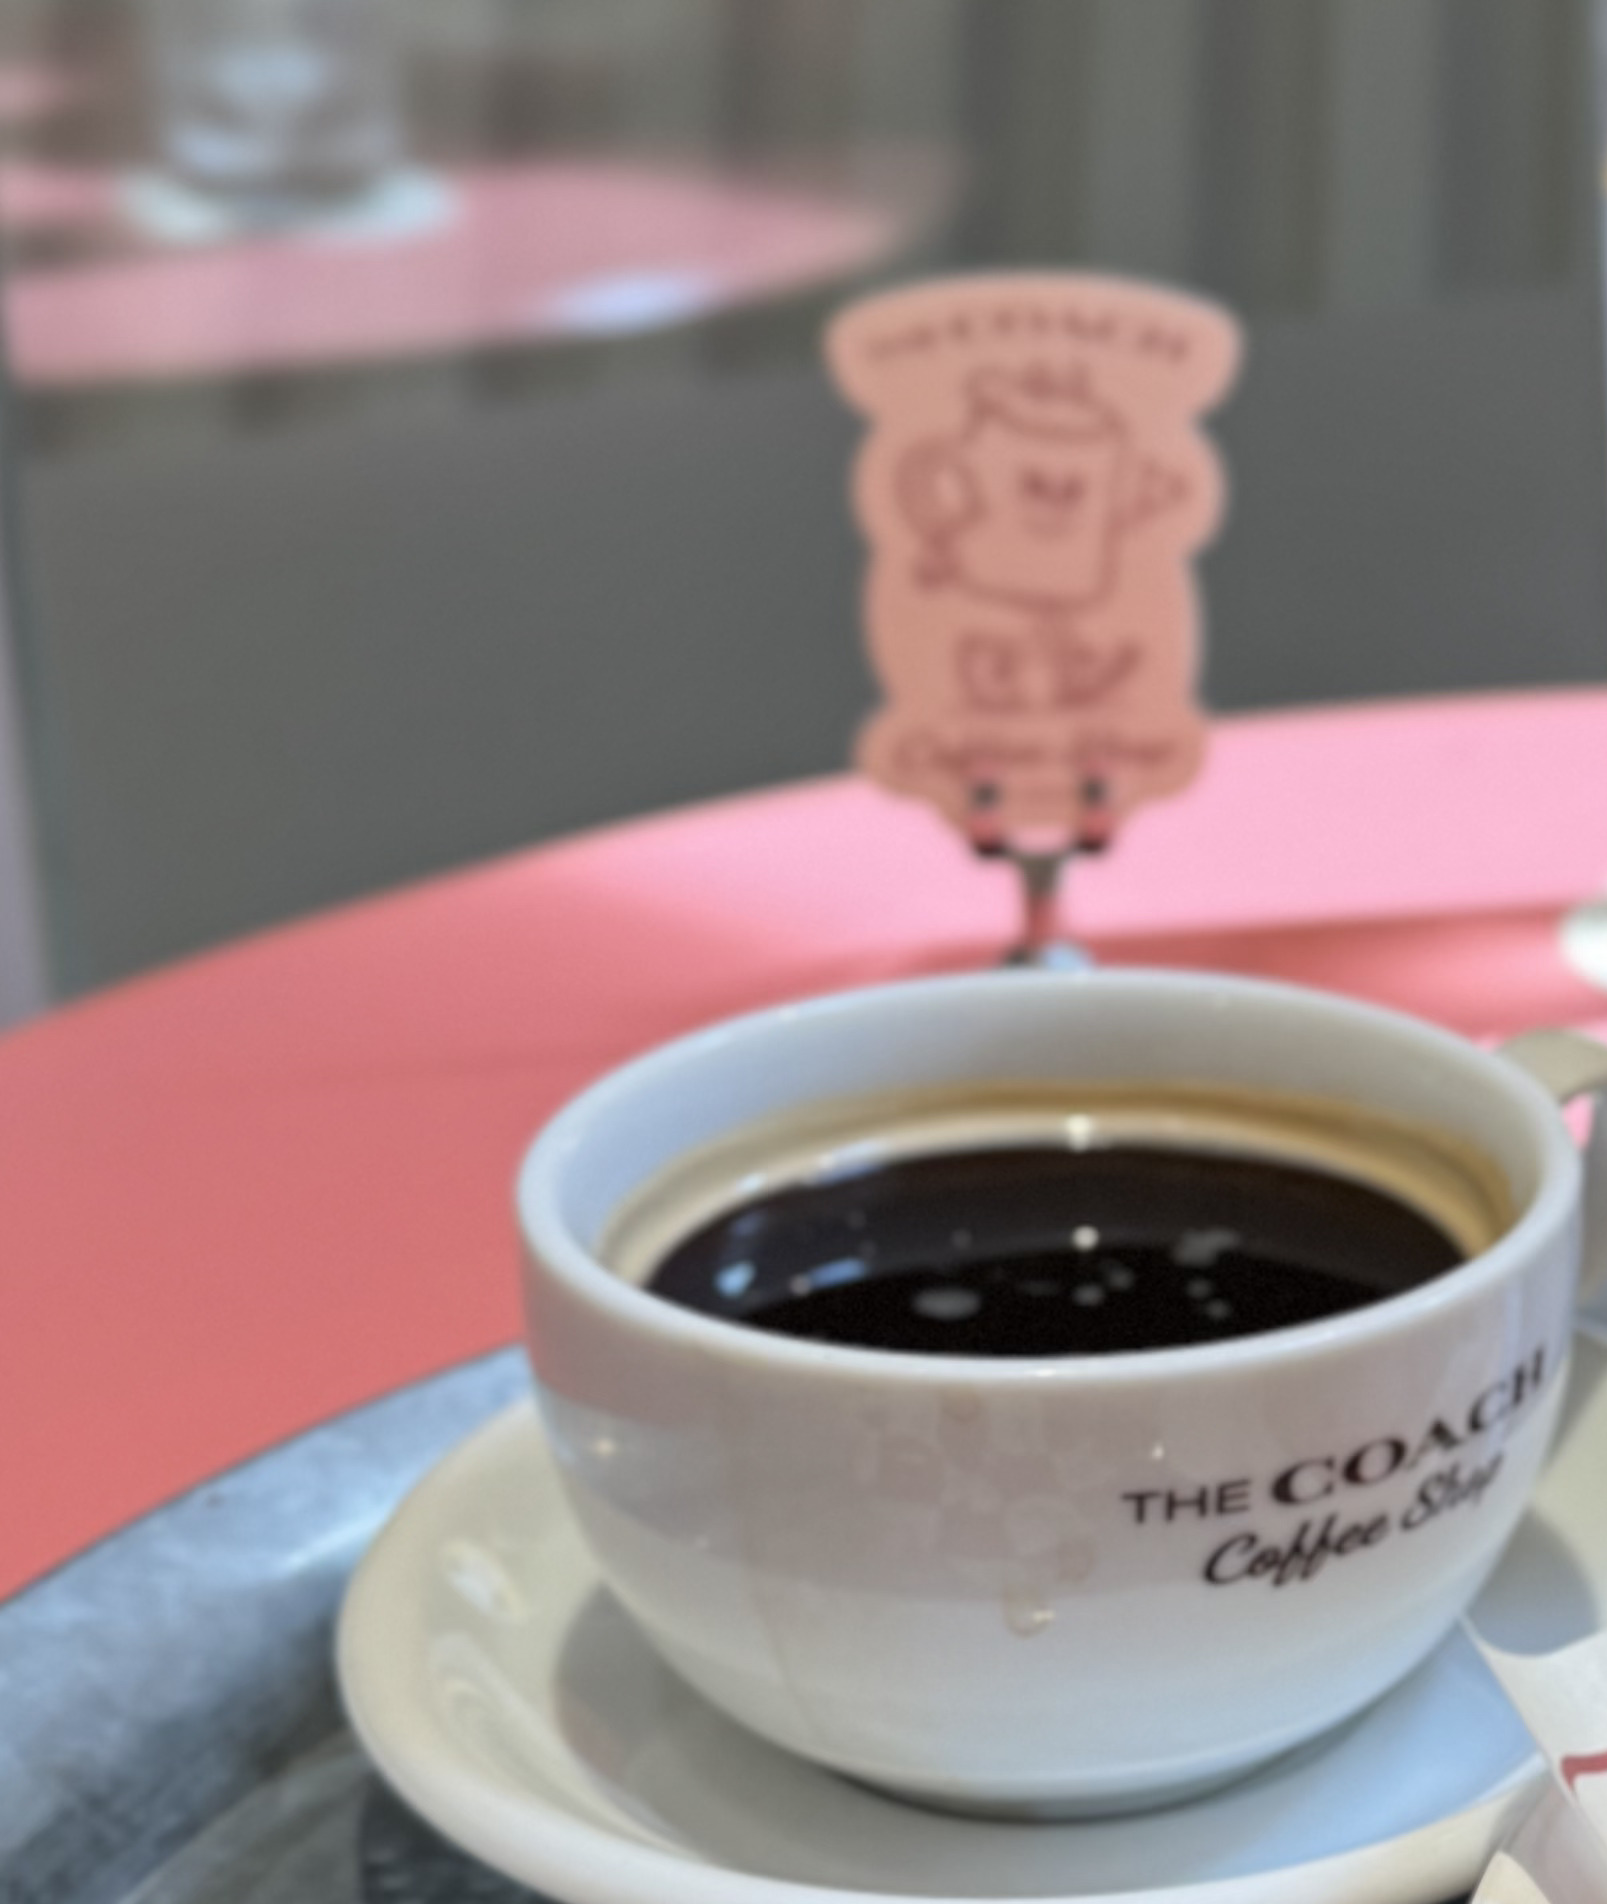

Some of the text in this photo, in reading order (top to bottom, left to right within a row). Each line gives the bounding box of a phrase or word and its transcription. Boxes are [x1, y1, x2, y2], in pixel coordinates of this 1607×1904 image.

[1121, 1342, 1546, 1524] THE COACH
[1203, 1450, 1504, 1588] Coffee Shop
